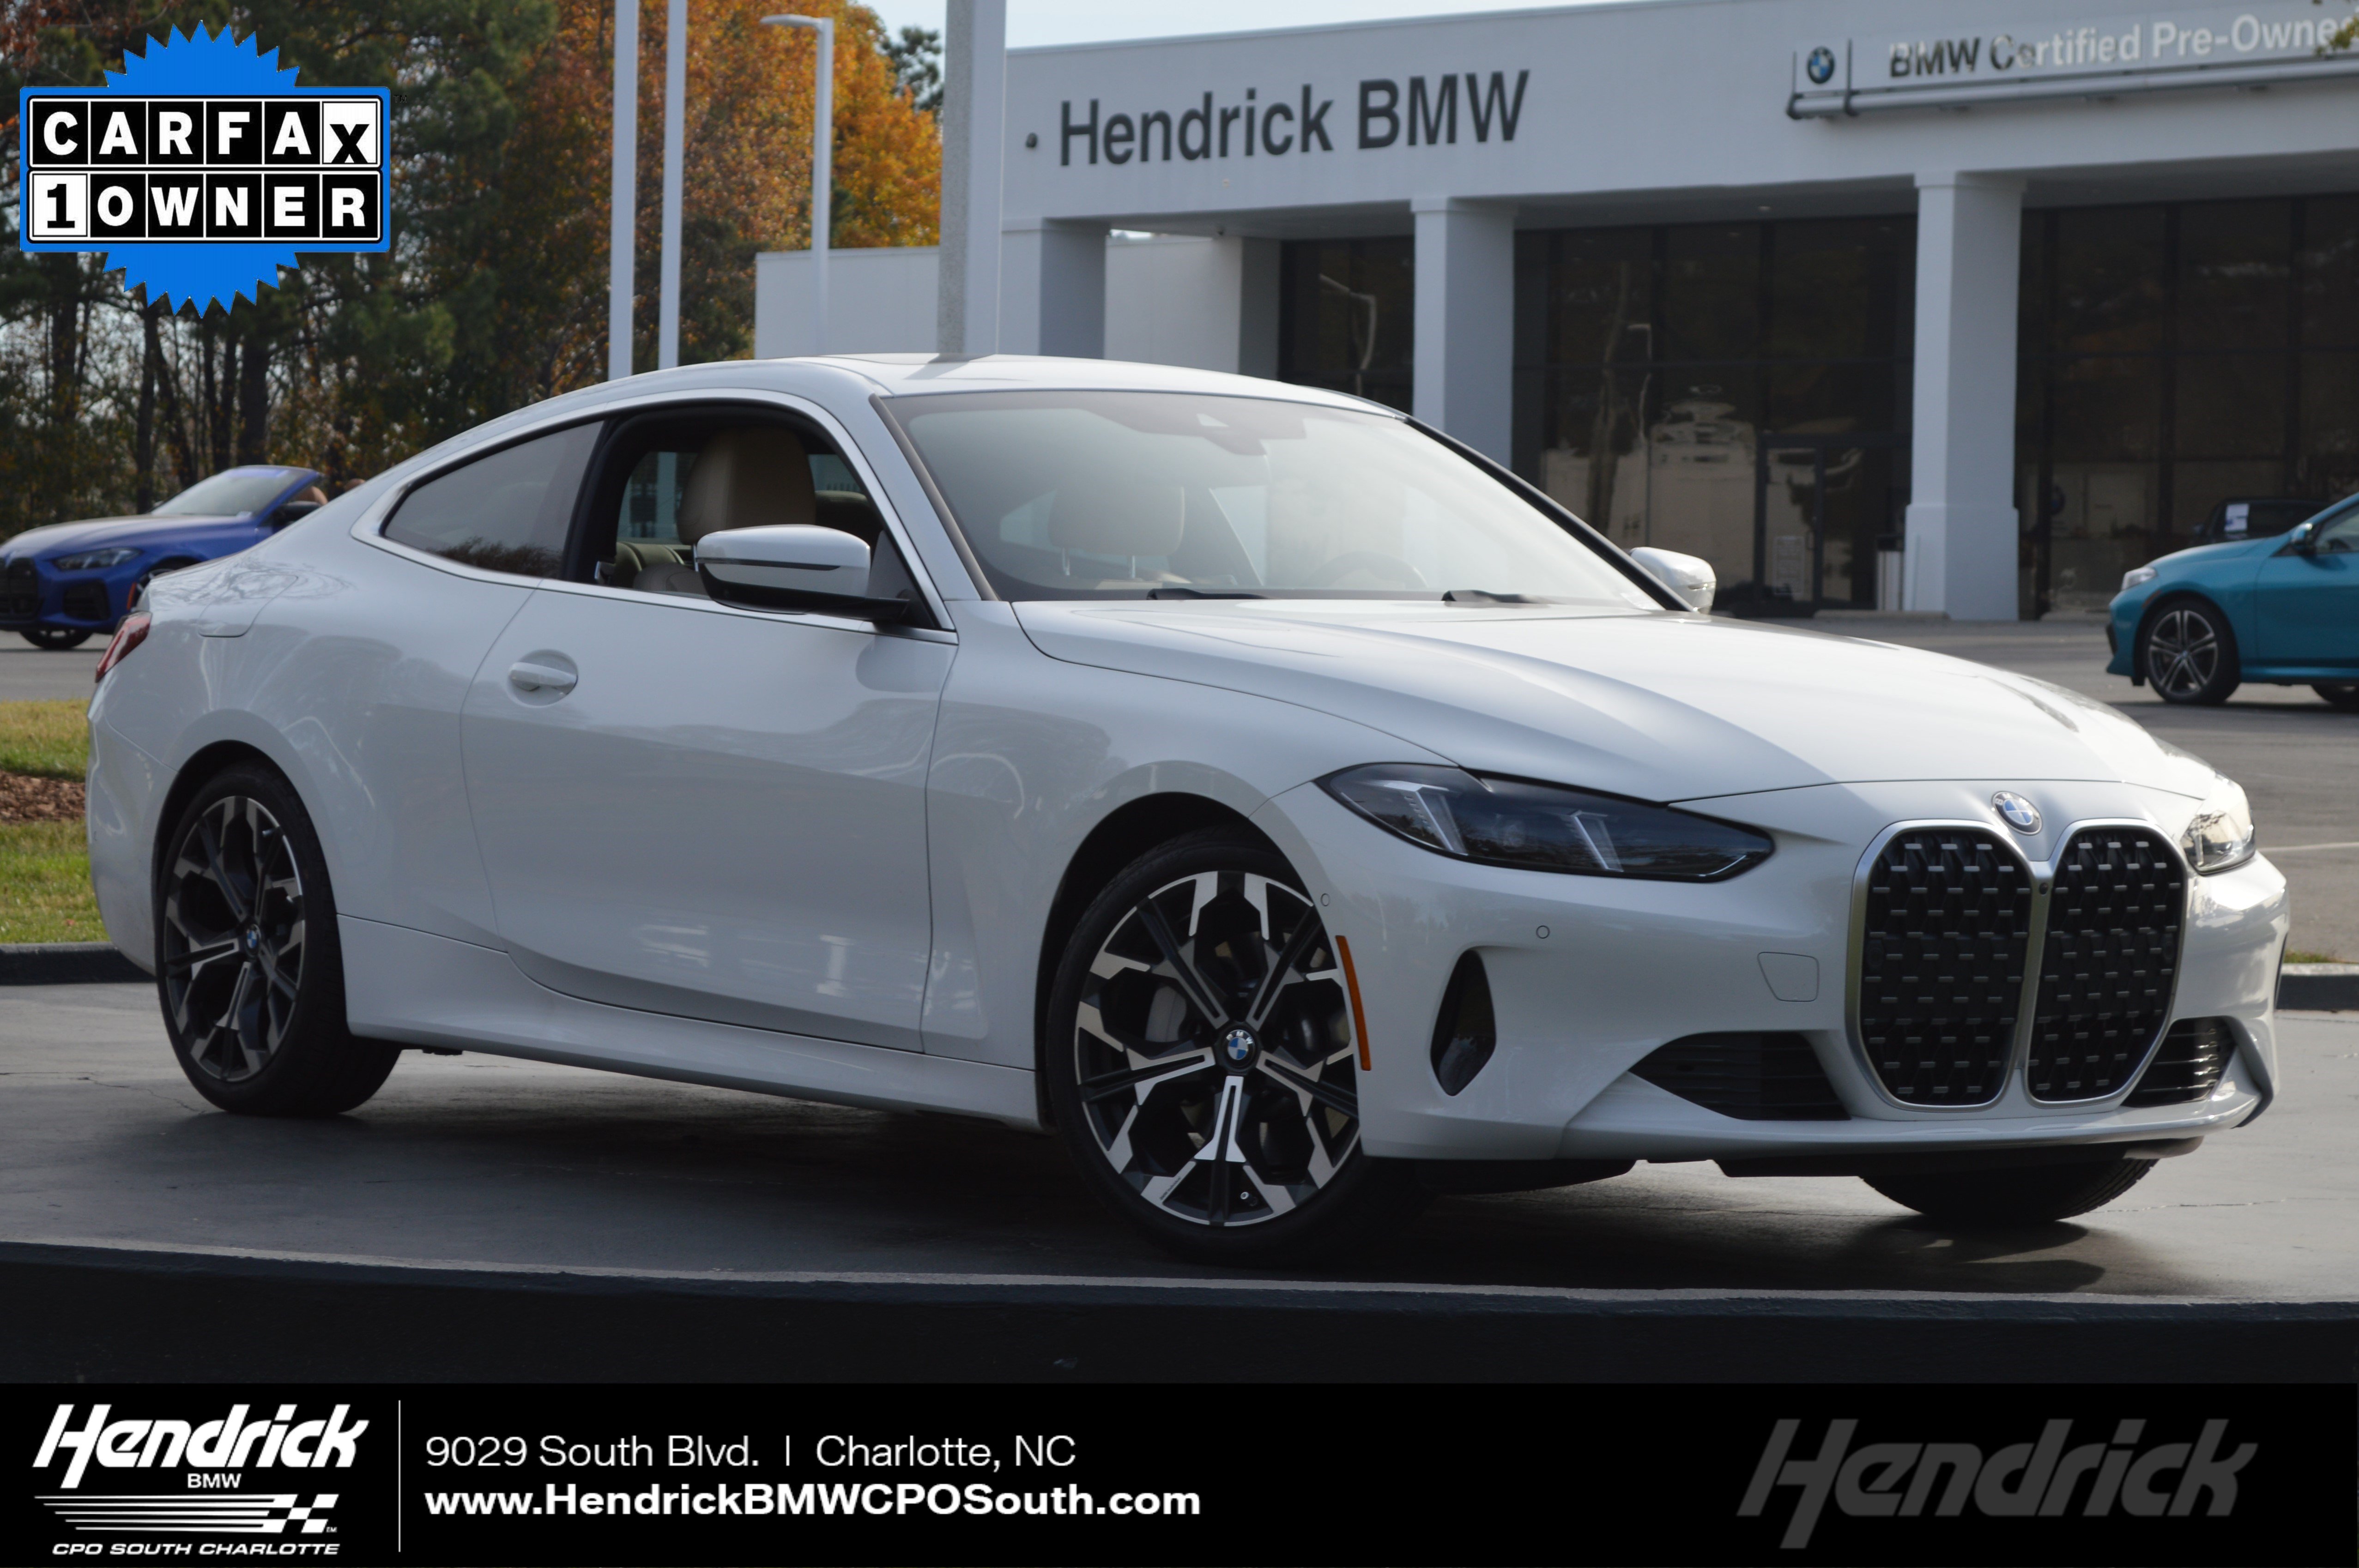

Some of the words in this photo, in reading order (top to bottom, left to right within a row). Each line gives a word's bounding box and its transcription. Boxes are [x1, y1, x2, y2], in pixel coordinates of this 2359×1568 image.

[1890, 37, 1980, 78] BMW
[1990, 24, 2141, 70] Certified
[1061, 85, 1334, 166] Hendrick
[1358, 70, 1530, 149] BMW
